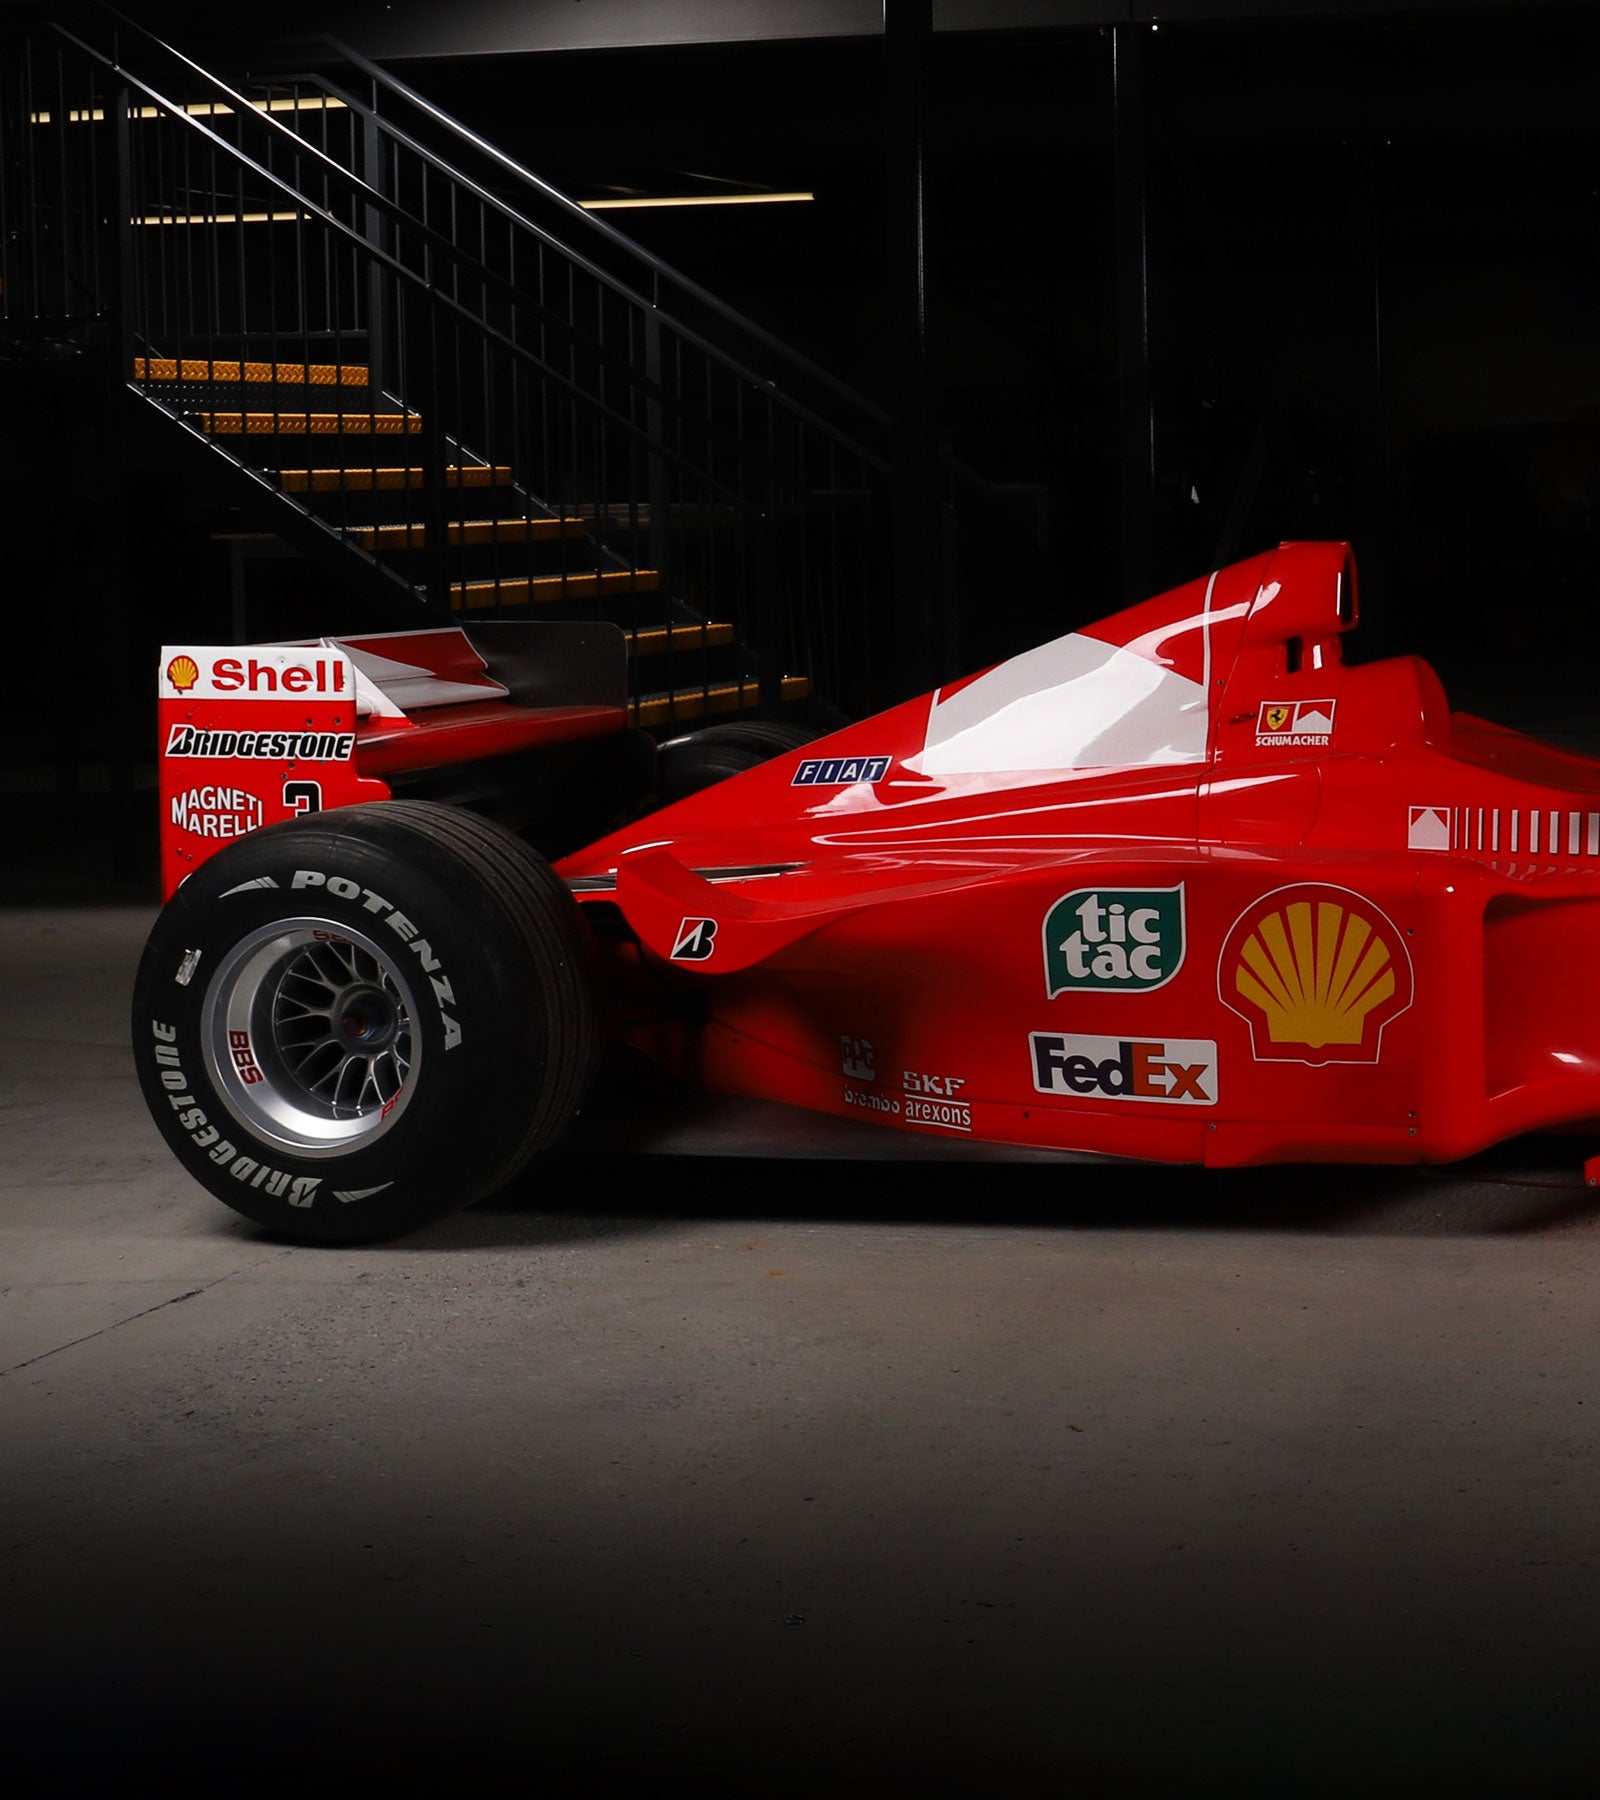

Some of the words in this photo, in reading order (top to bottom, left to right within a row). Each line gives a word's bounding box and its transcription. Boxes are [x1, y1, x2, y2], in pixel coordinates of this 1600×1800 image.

[211, 658, 344, 693] Shell
[166, 725, 355, 760] BRIDGESTONE
[1255, 735, 1329, 747] SCHUMACHER
[798, 760, 885, 782] FIAT
[171, 786, 263, 818] MAGNETI
[171, 803, 263, 838] MARELLI
[1075, 893, 1161, 944] tic
[290, 870, 463, 1051] POTENZA
[1059, 930, 1162, 980] tac
[229, 1030, 265, 1085] BBS
[1033, 1035, 1211, 1101] FedEx
[902, 1070, 966, 1096] SKF
[151, 1019, 324, 1208] BRIDGESTONE
[904, 1099, 972, 1126] arexons
